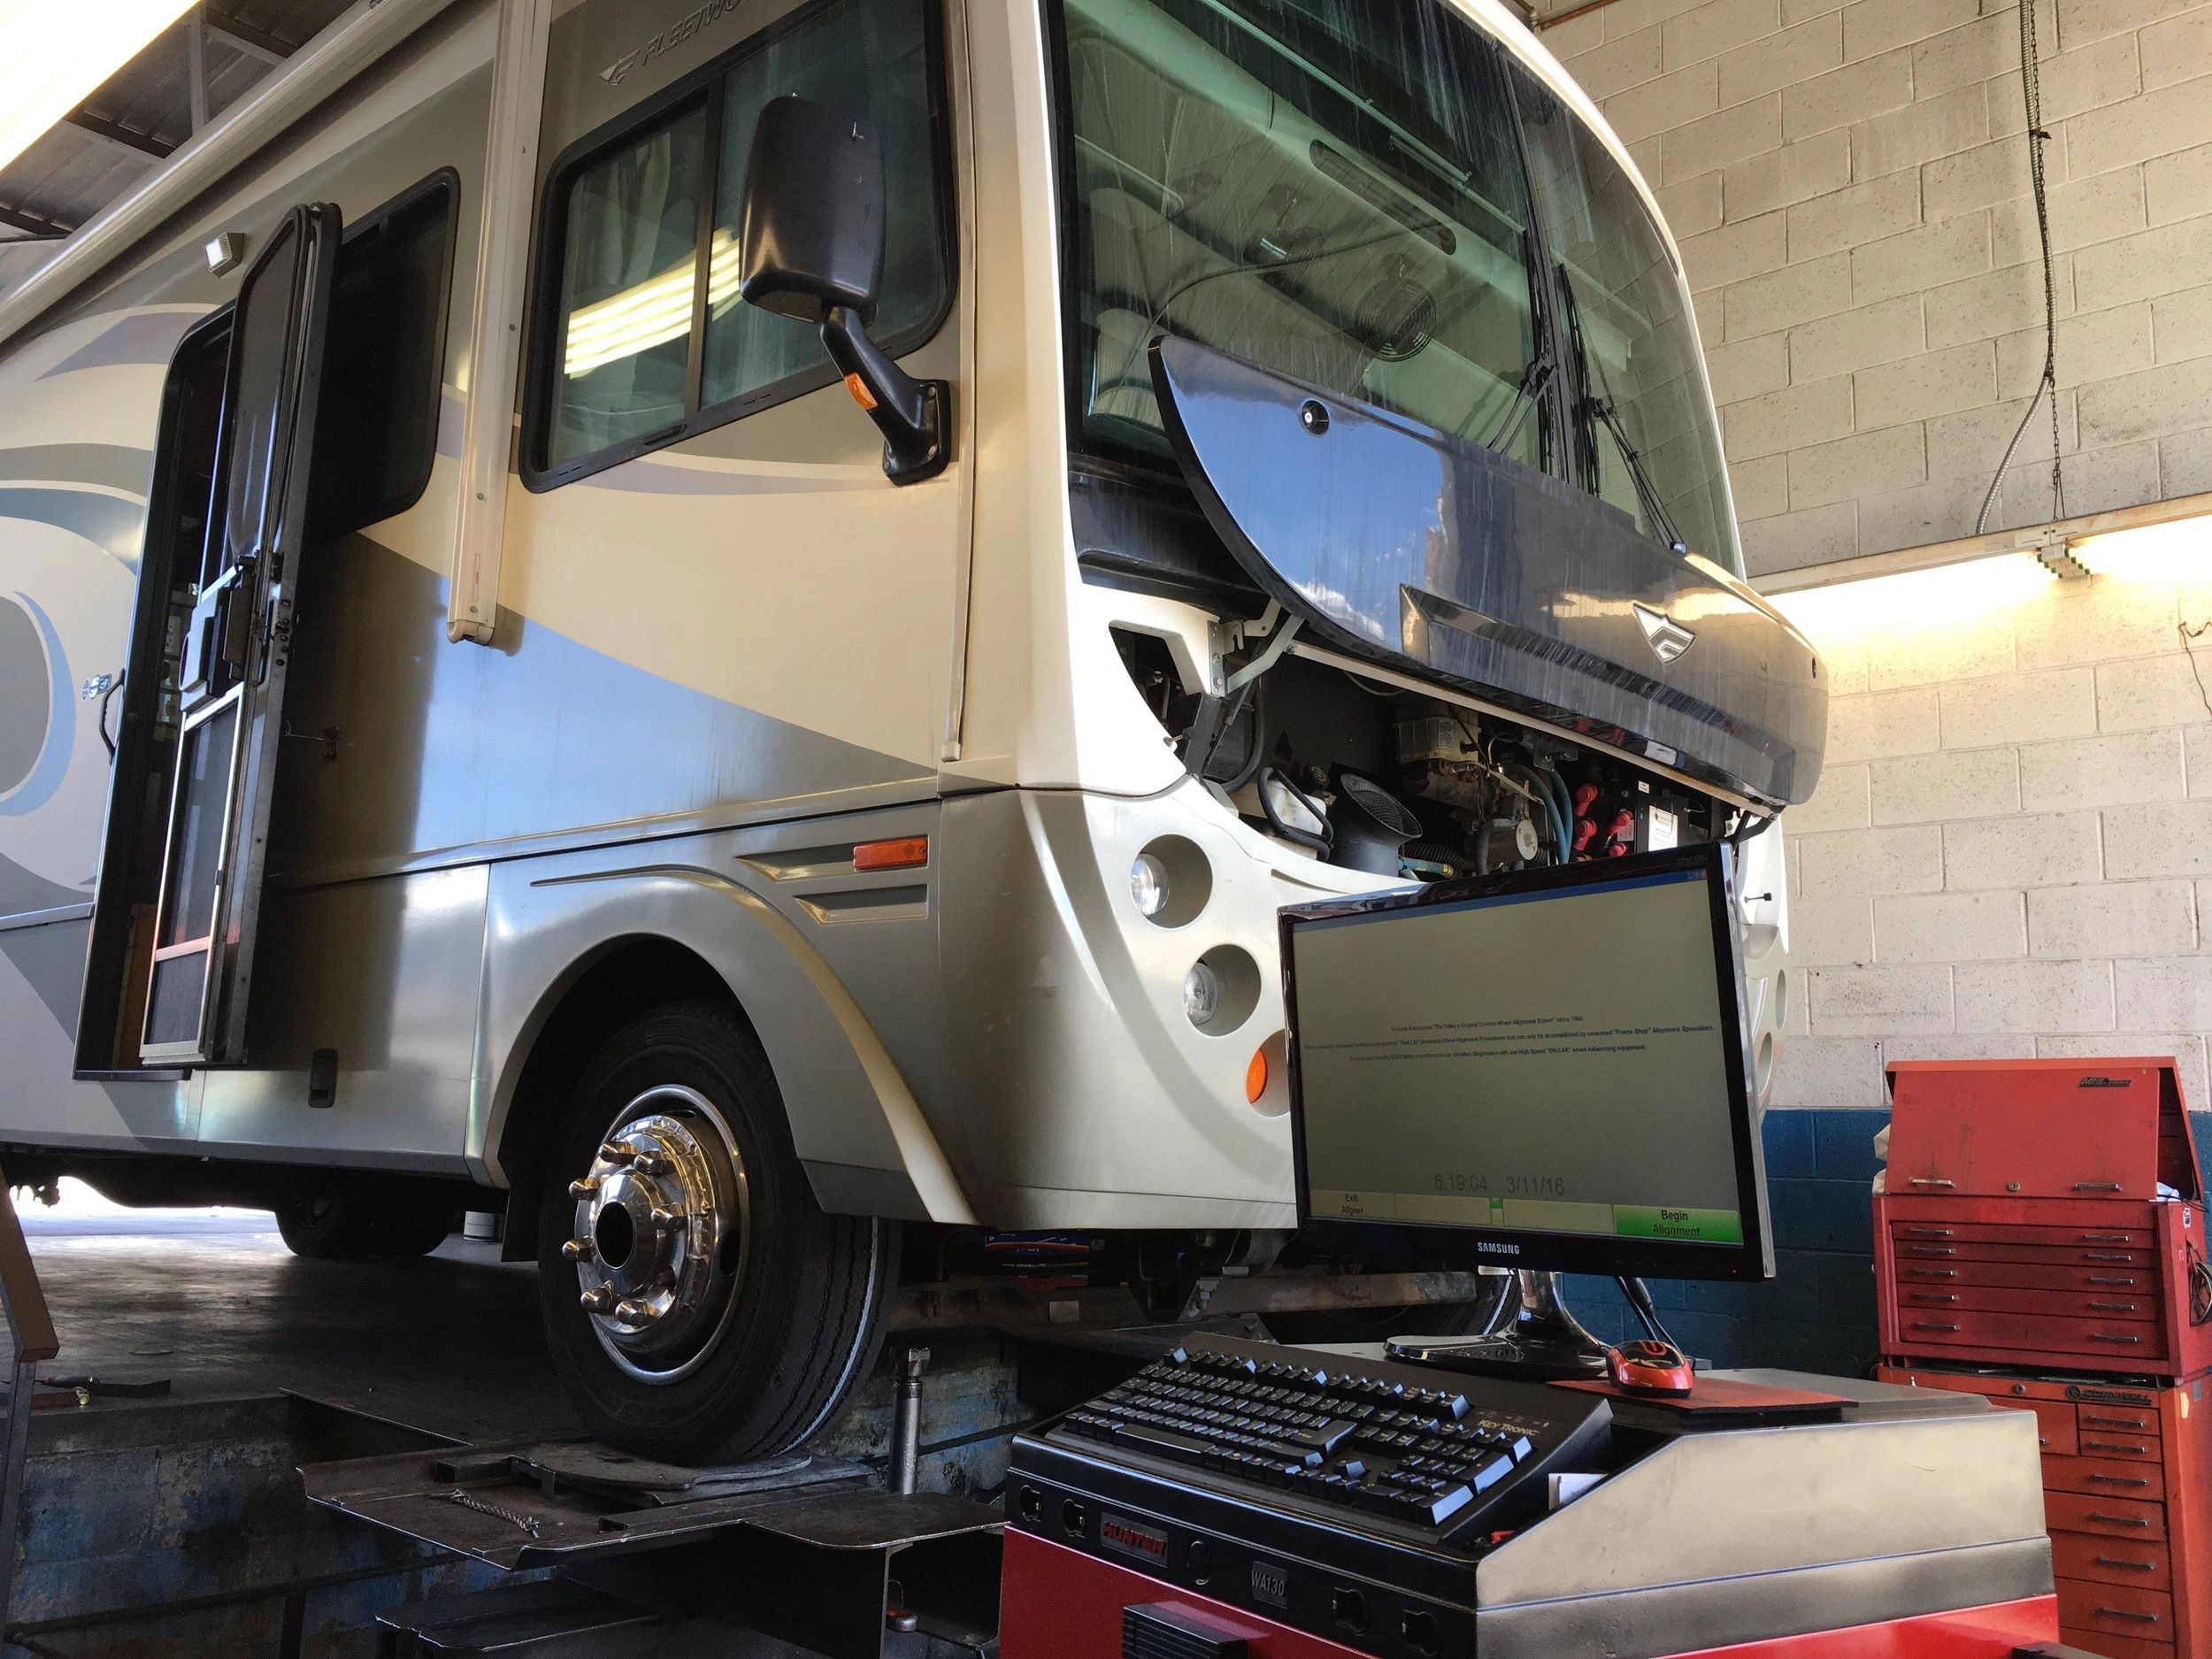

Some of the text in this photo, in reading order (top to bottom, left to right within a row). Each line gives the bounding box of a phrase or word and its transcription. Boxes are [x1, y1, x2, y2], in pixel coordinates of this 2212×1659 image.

[1652, 1026, 1681, 1035] Alignment
[1506, 1175, 1565, 1195] 3/11/16
[1661, 1210, 1688, 1222] Begin
[1652, 1224, 1701, 1237] Alignment
[1477, 1241, 1520, 1255] SAMSUNG
[1102, 1521, 1167, 1558] HUNTER
[1251, 1570, 1286, 1596] WA130
